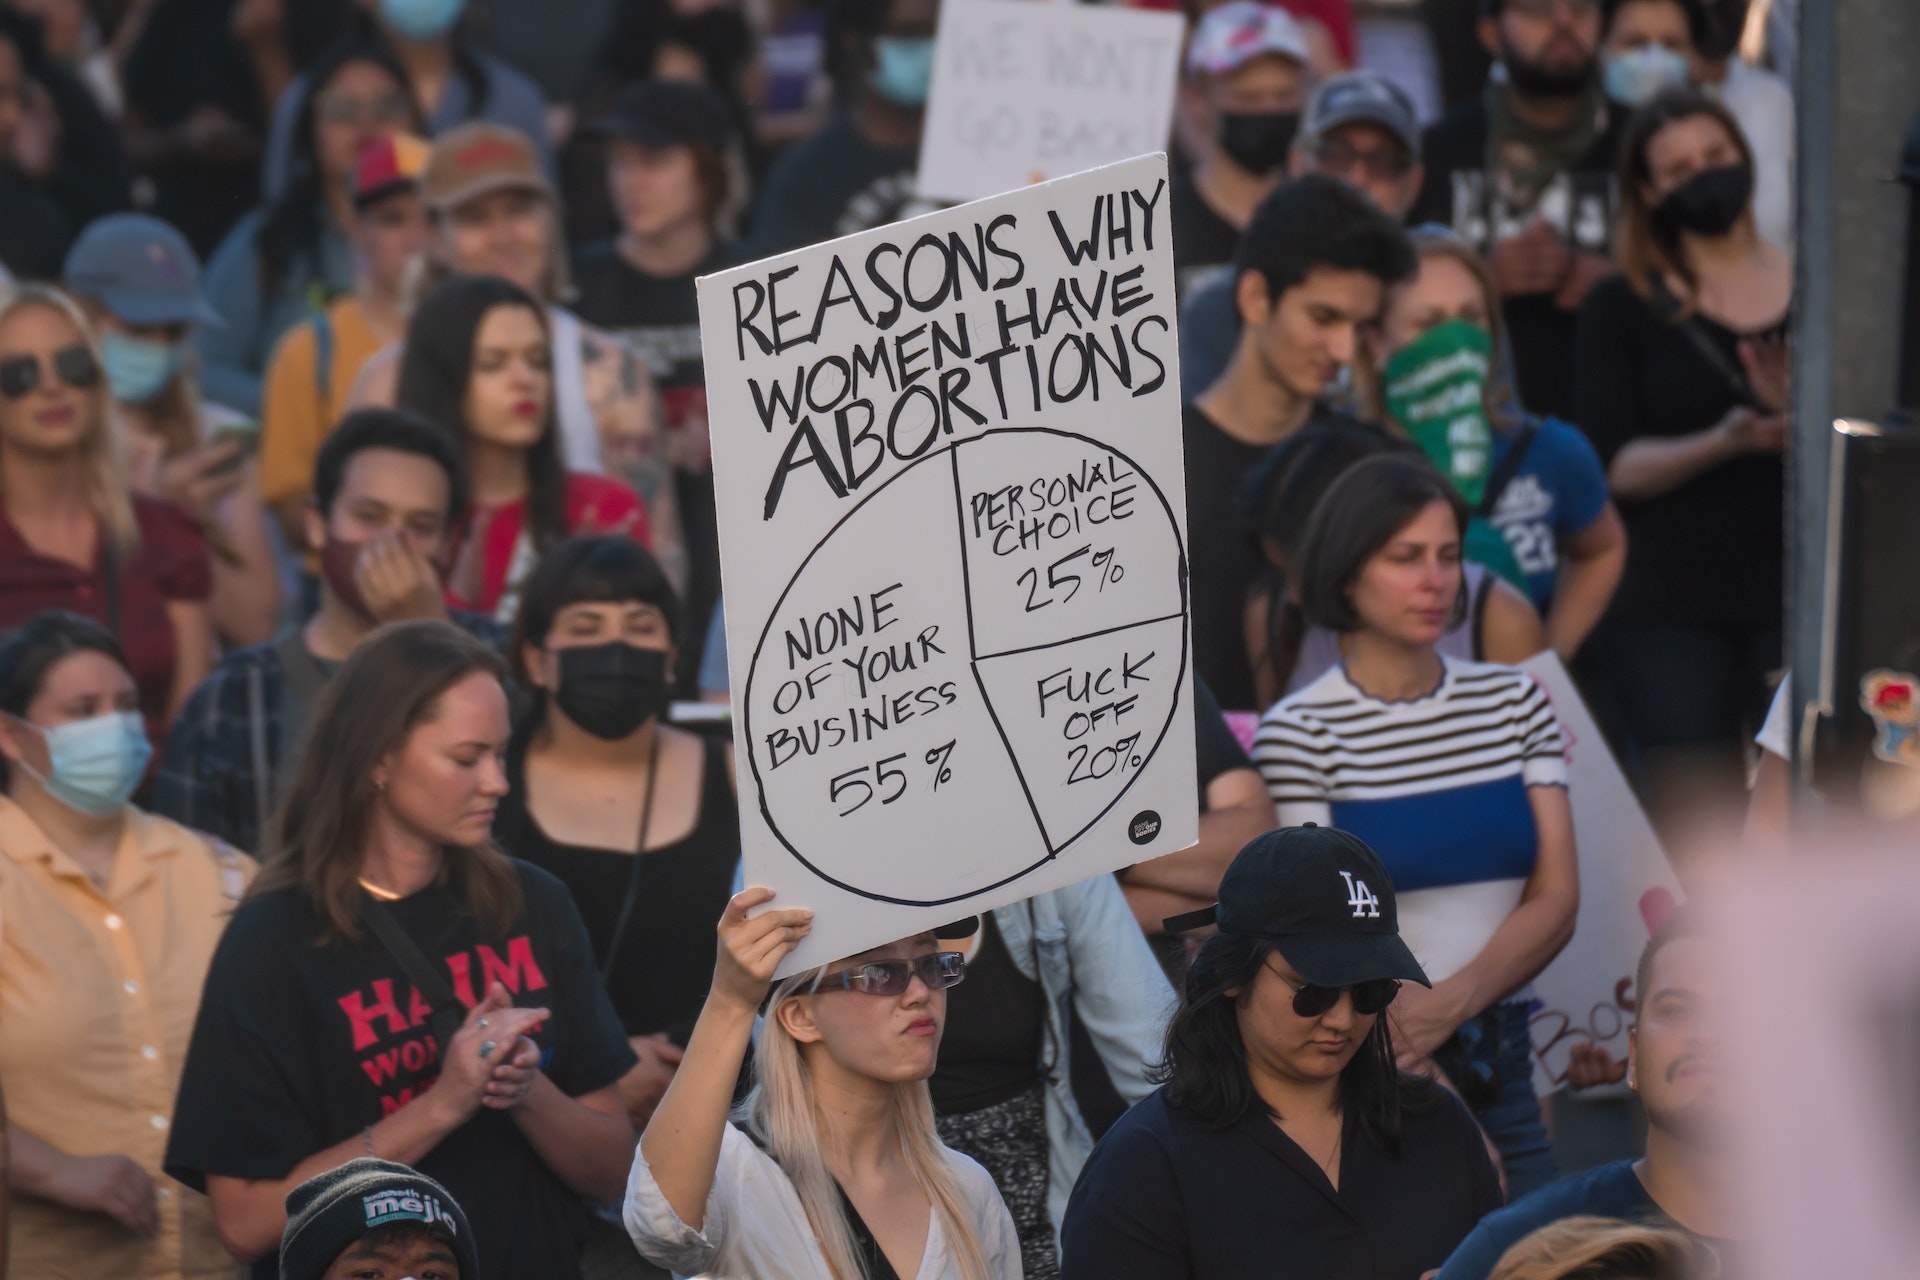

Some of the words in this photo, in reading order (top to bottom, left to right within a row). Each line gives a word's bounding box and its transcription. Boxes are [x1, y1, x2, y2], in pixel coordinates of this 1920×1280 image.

[950, 18, 1025, 83] WE
[952, 99, 1021, 158] GO
[732, 214, 1025, 361] REASONS
[1047, 178, 1166, 267] WHY
[748, 312, 972, 432] WOMEN
[996, 264, 1154, 347] HAVE
[763, 315, 1169, 521] ABORTIONS
[970, 456, 1133, 538] PERSONAL
[993, 484, 1137, 556] CHOICE
[1016, 543, 1124, 612] 25%
[784, 582, 903, 670] NONE
[773, 662, 833, 716] OF
[842, 625, 946, 698] YOUR
[1037, 651, 1155, 718] FUCK
[765, 681, 957, 770] BUSINESS
[1063, 694, 1138, 741] OFF
[1066, 731, 1142, 786] 20%
[1135, 827, 1157, 838] BODIES
[1339, 870, 1379, 918] LA
[363, 1194, 457, 1237] mejia
